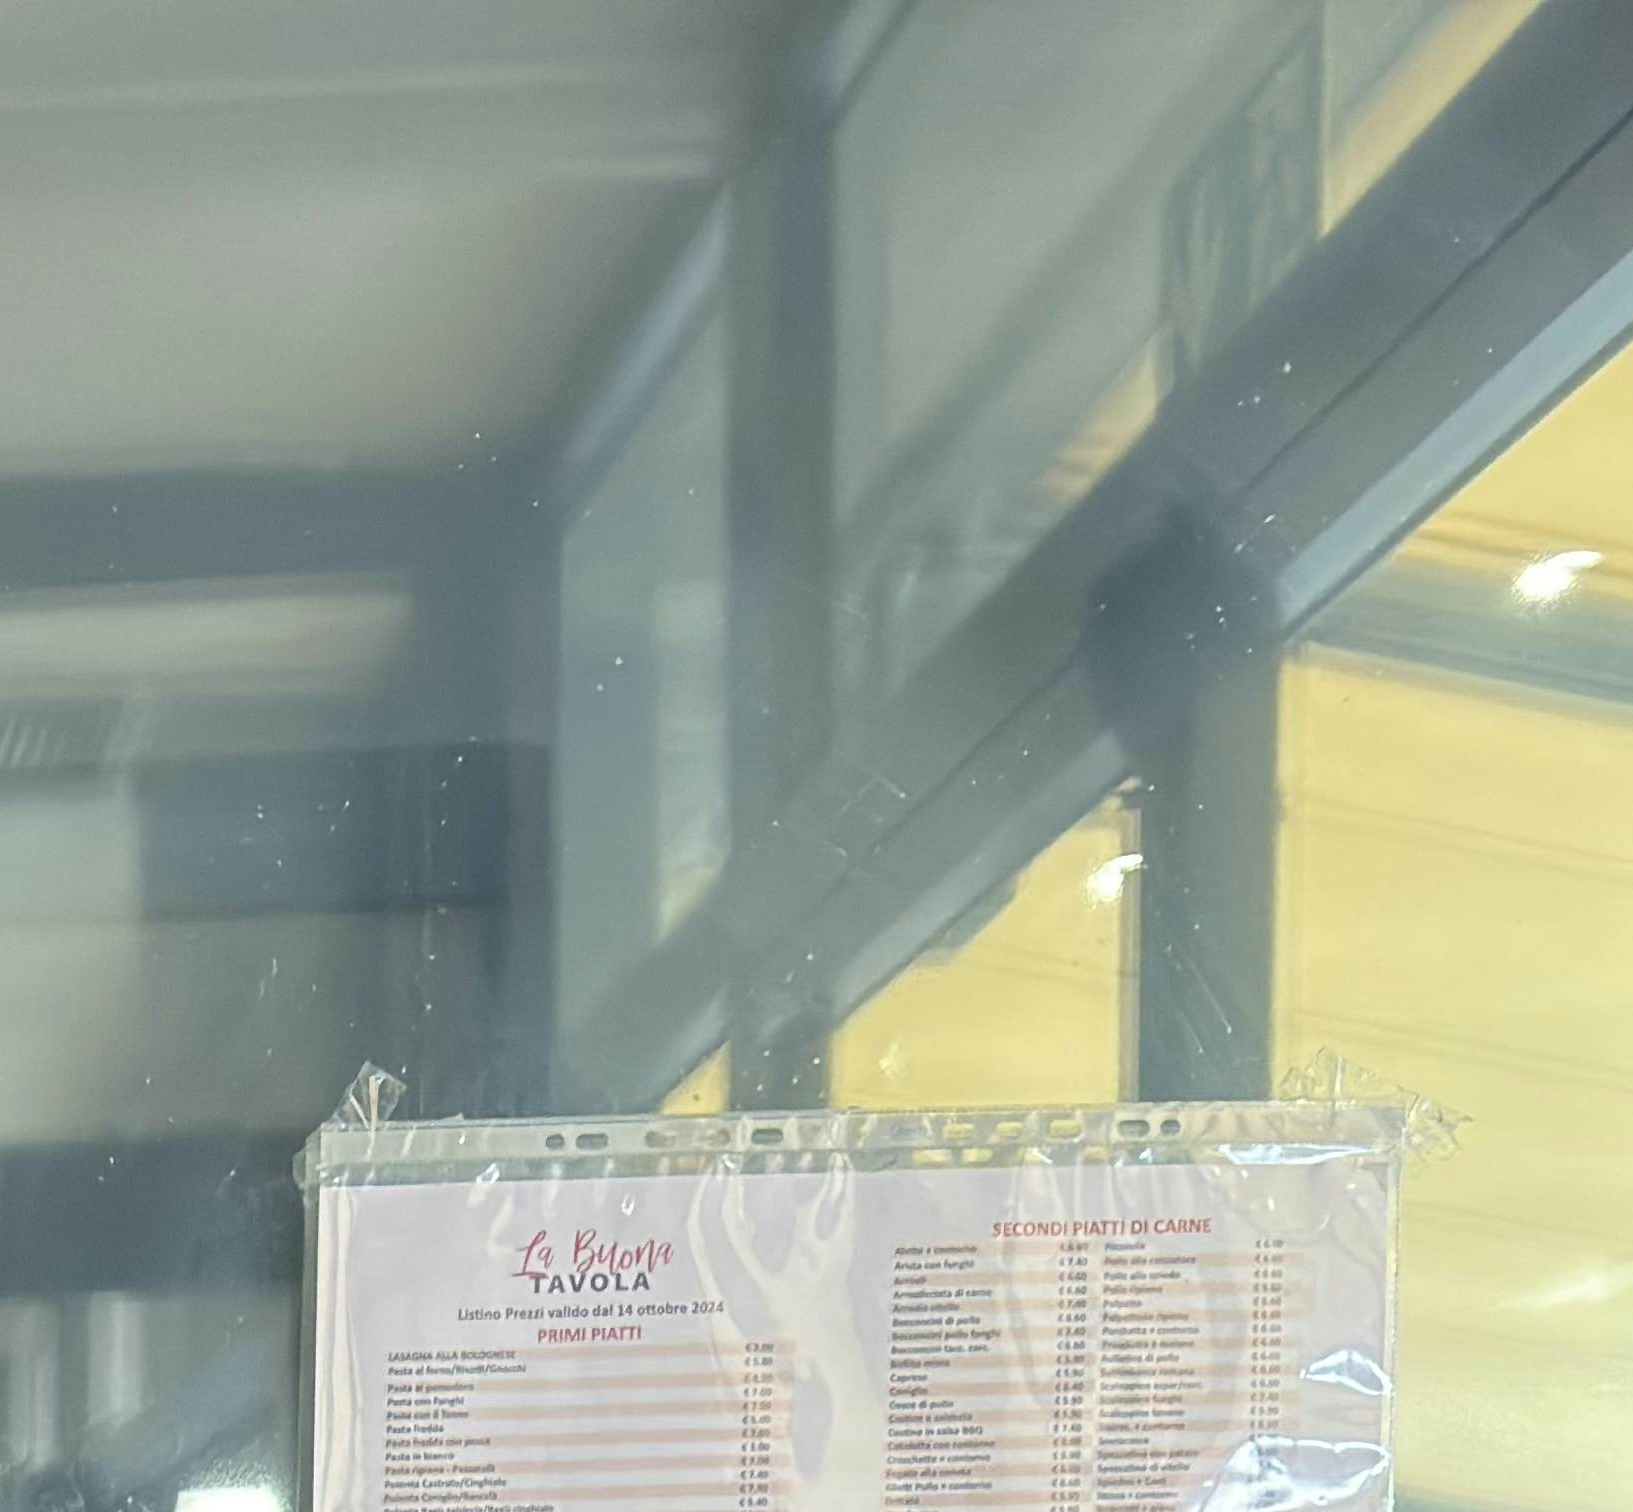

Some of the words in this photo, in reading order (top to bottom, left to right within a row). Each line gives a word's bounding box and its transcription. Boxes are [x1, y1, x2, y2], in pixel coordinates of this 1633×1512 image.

[992, 1221, 1067, 1238] SECONDI
[1072, 1220, 1125, 1236] PIATTI
[1130, 1219, 1149, 1235] DI
[1153, 1217, 1212, 1234] CARNE
[512, 1230, 554, 1277] La
[573, 1229, 674, 1276] Buona
[531, 1271, 651, 1294] TAVOLA
[458, 1308, 501, 1321] Listino
[505, 1307, 544, 1320] Prezzi
[548, 1305, 588, 1319] valido
[592, 1304, 613, 1317] dal
[618, 1304, 633, 1316] 14
[637, 1302, 687, 1316] ottobre
[691, 1301, 724, 1314] 2024
[537, 1328, 586, 1344] PRIMI
[591, 1326, 642, 1342] PIATTI
